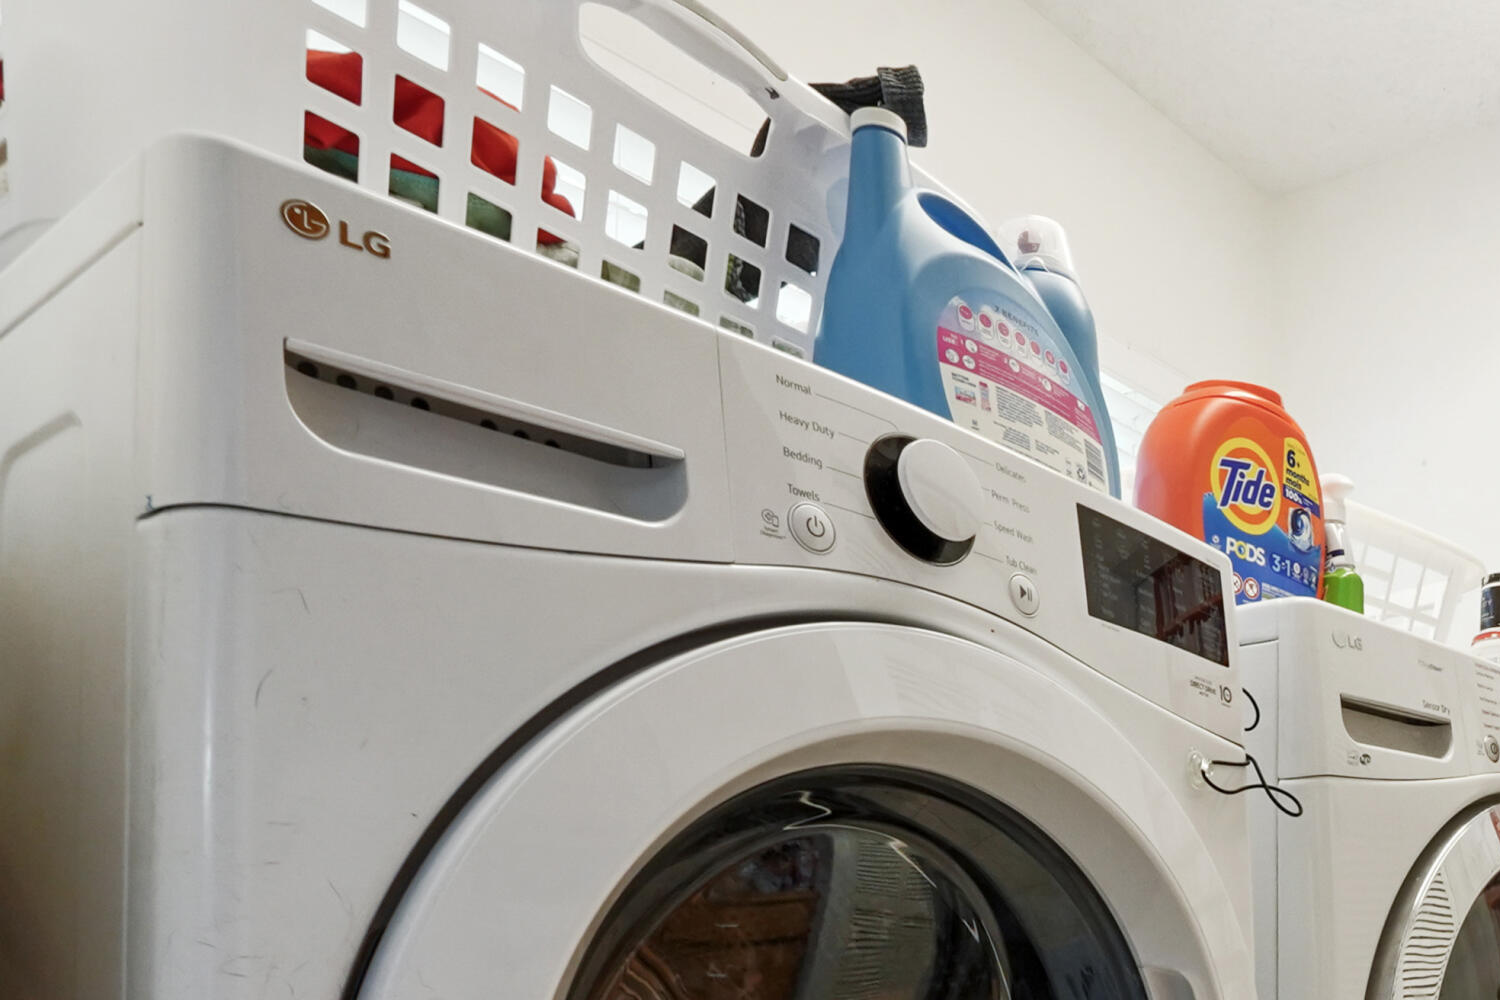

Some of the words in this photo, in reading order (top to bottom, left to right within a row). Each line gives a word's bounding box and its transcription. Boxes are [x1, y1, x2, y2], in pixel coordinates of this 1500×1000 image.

[339, 219, 391, 260] LG
[775, 374, 812, 396] Normal
[779, 410, 810, 431] Heavy
[812, 421, 835, 439] Duty
[783, 446, 823, 470] Bedding
[995, 462, 1026, 482] Delicates
[787, 483, 820, 501] Towels
[1217, 457, 1276, 511] Tide
[994, 520, 1015, 536] Speed
[1226, 536, 1266, 566] PODS
[1347, 635, 1362, 651] LG
